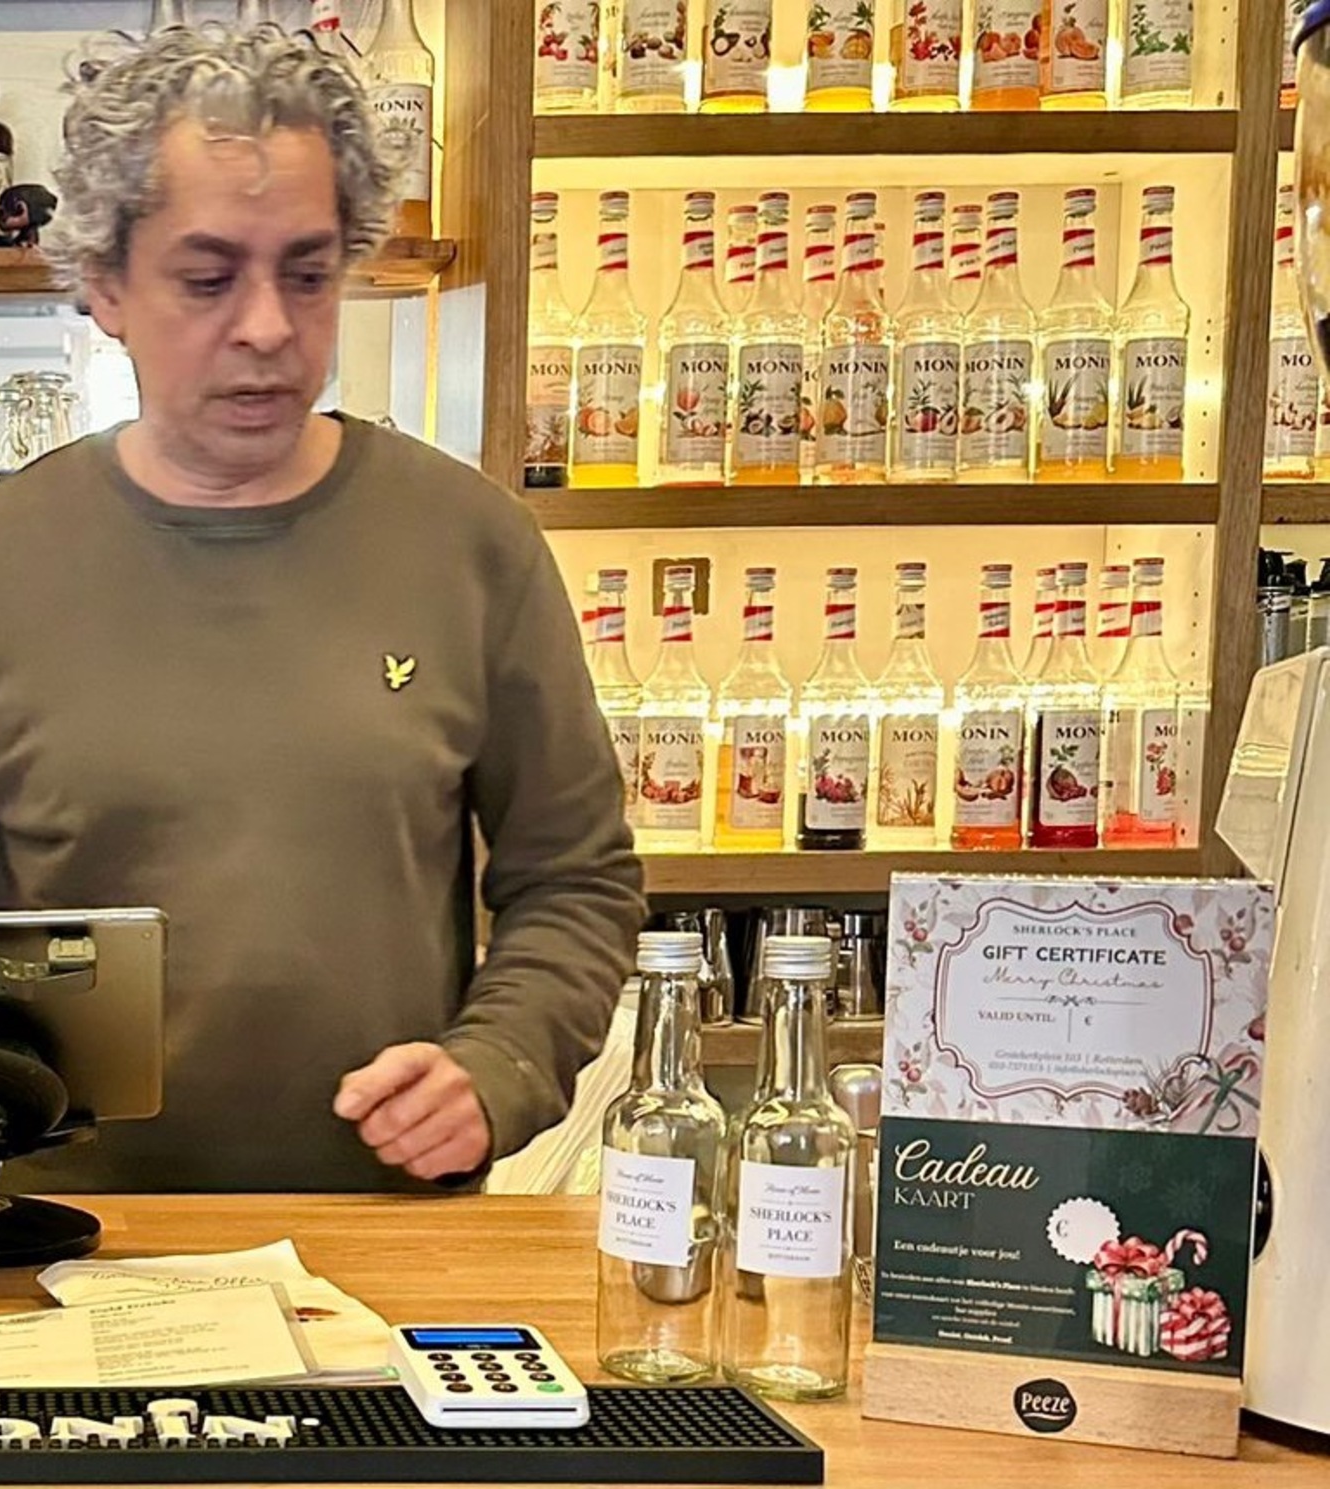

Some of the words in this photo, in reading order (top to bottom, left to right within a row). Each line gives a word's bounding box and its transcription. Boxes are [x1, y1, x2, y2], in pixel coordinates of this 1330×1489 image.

[374, 100, 424, 112] ONIN
[531, 364, 569, 376] MON
[746, 732, 785, 742] MON
[821, 731, 867, 743] MON
[893, 731, 937, 742] MON
[963, 727, 1009, 740] ONIN
[1056, 727, 1100, 740] MON
[1013, 925, 1093, 936] SHERLOCK'S
[1097, 927, 1136, 937] PLACE
[983, 945, 1028, 960] GIFT
[1036, 946, 1166, 965] CERTIFICATE
[983, 966, 1055, 991] Merry
[1058, 967, 1164, 988] Christmas
[978, 1010, 1014, 1021] VALID
[1016, 1011, 1057, 1023] UNTIL:
[894, 1138, 1039, 1191] Cadeau
[894, 1186, 975, 1209] KAART
[616, 1211, 657, 1229] PLACE
[749, 1206, 832, 1223] SHERLOCK'S
[768, 1227, 814, 1242] PLACE
[894, 1240, 915, 1250] Een
[916, 1242, 969, 1258] cadeautje
[971, 1248, 996, 1258] voor
[998, 1249, 1021, 1261] jou!
[1021, 1390, 1070, 1413] Peeze
